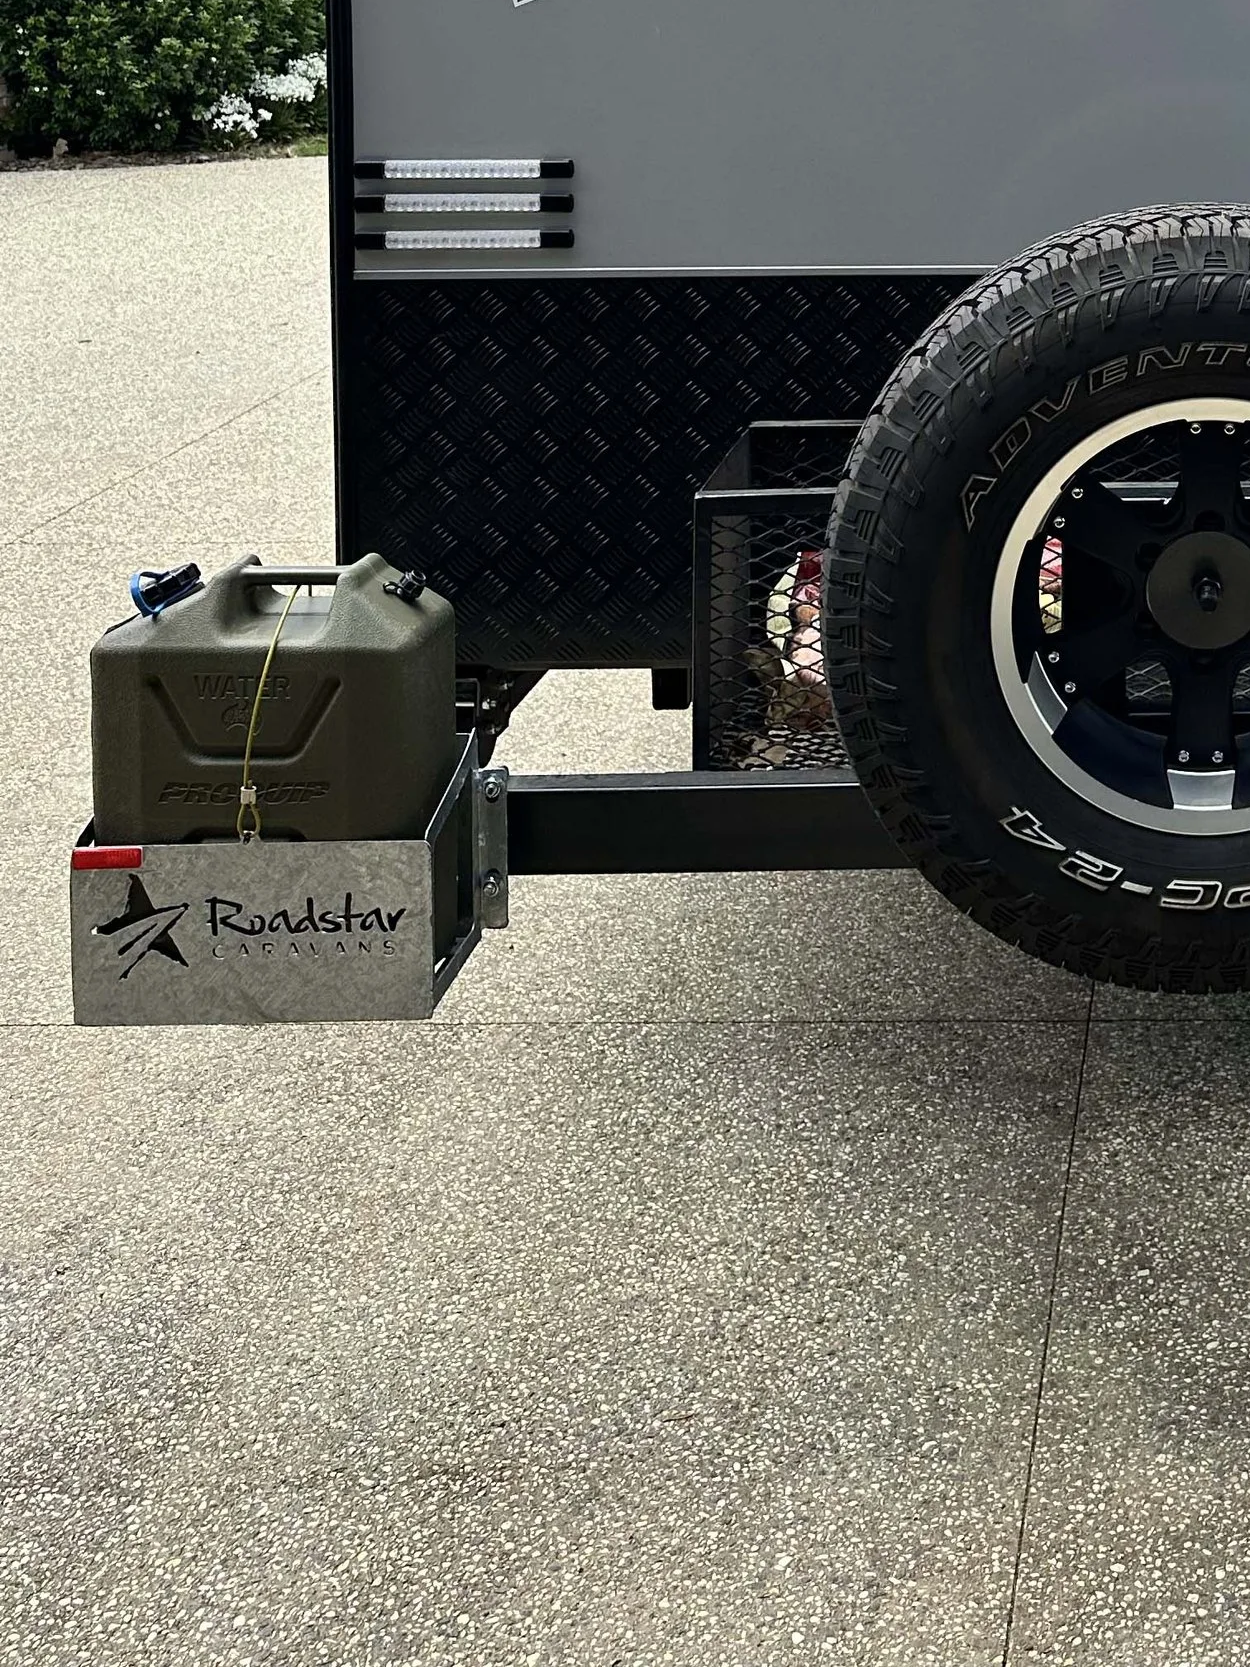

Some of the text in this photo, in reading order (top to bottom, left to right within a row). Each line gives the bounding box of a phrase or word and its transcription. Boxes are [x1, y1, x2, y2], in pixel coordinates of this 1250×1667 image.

[193, 674, 291, 700] WATER
[205, 892, 407, 936] Roadstar
[212, 940, 396, 960] CARAVANS
